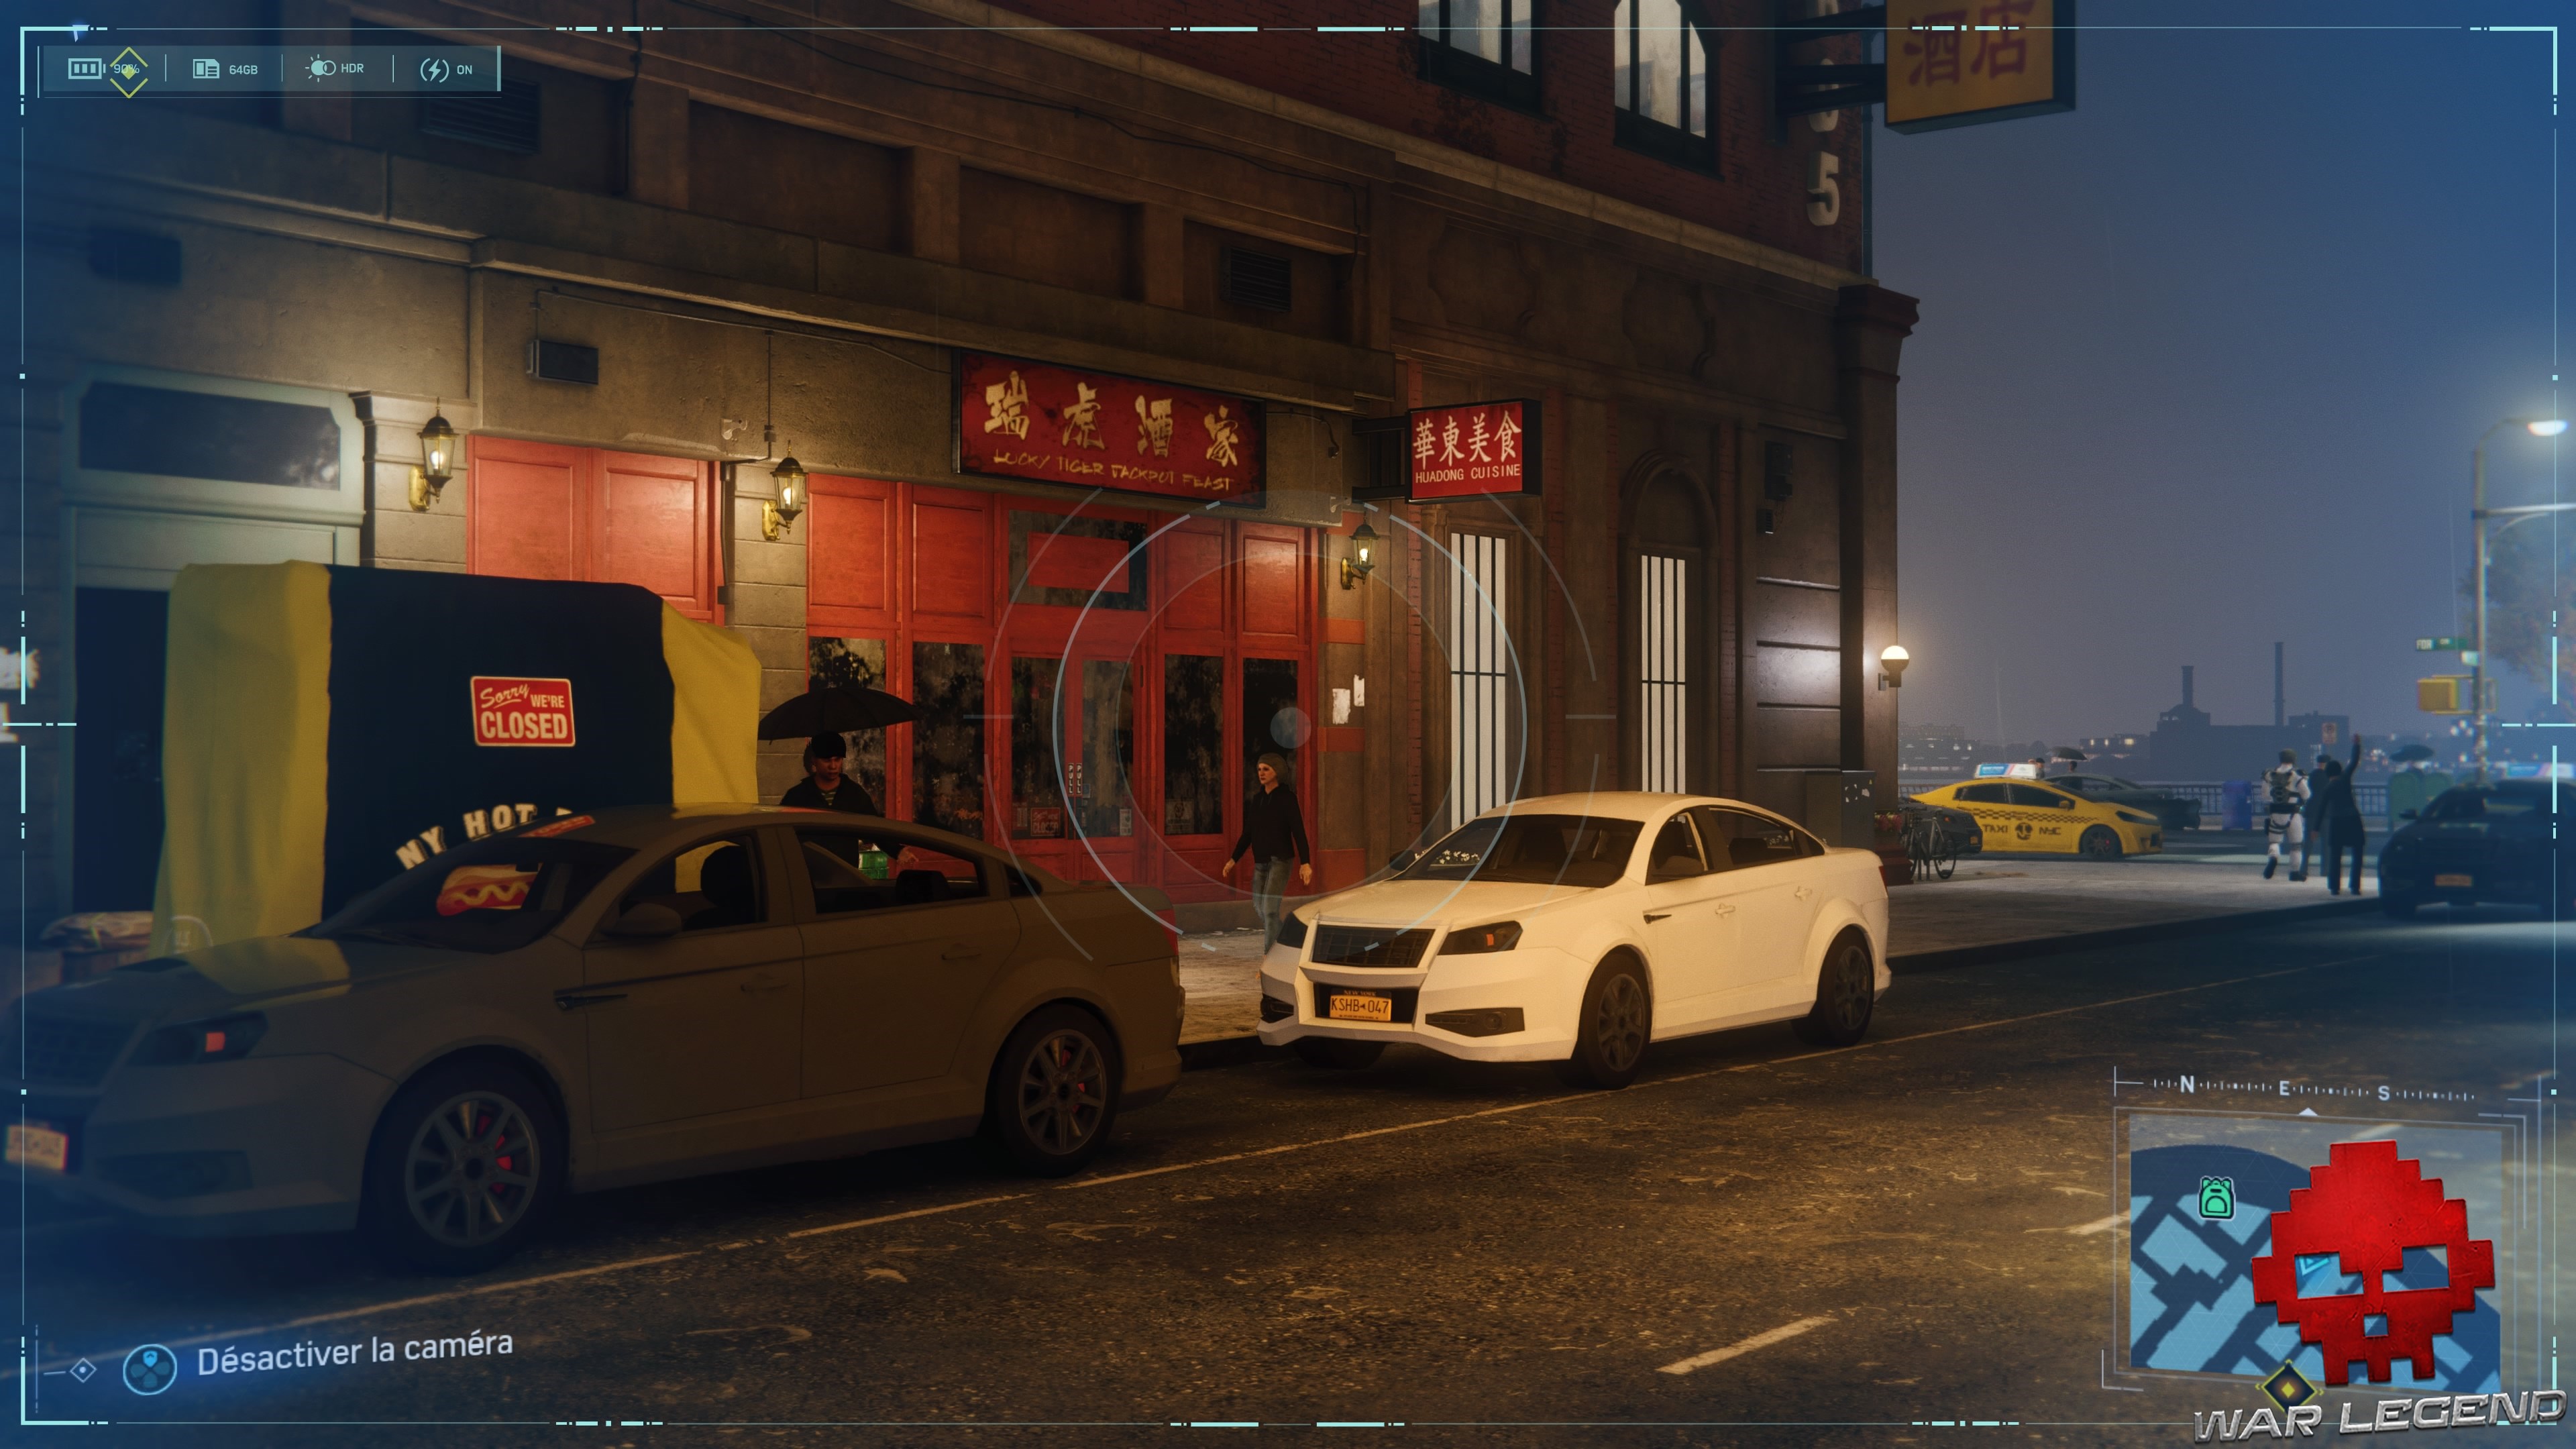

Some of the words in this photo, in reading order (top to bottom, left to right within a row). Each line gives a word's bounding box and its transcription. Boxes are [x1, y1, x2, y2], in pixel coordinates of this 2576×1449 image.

[1412, 410, 1522, 470] 華東美食
[993, 448, 1051, 469] LUCKY
[1057, 455, 1106, 476] TIGER
[1110, 463, 1175, 485] JACKPOT
[1182, 473, 1235, 492] FEAST
[1415, 468, 1464, 484] HUADONG
[1470, 464, 1521, 480] CUISINE
[479, 683, 530, 709] Sorry
[530, 694, 565, 708] WE'RE
[480, 711, 568, 739] CLOSED
[395, 824, 447, 871] NY
[463, 803, 538, 840] HOT
[1982, 824, 2008, 833] TAXI
